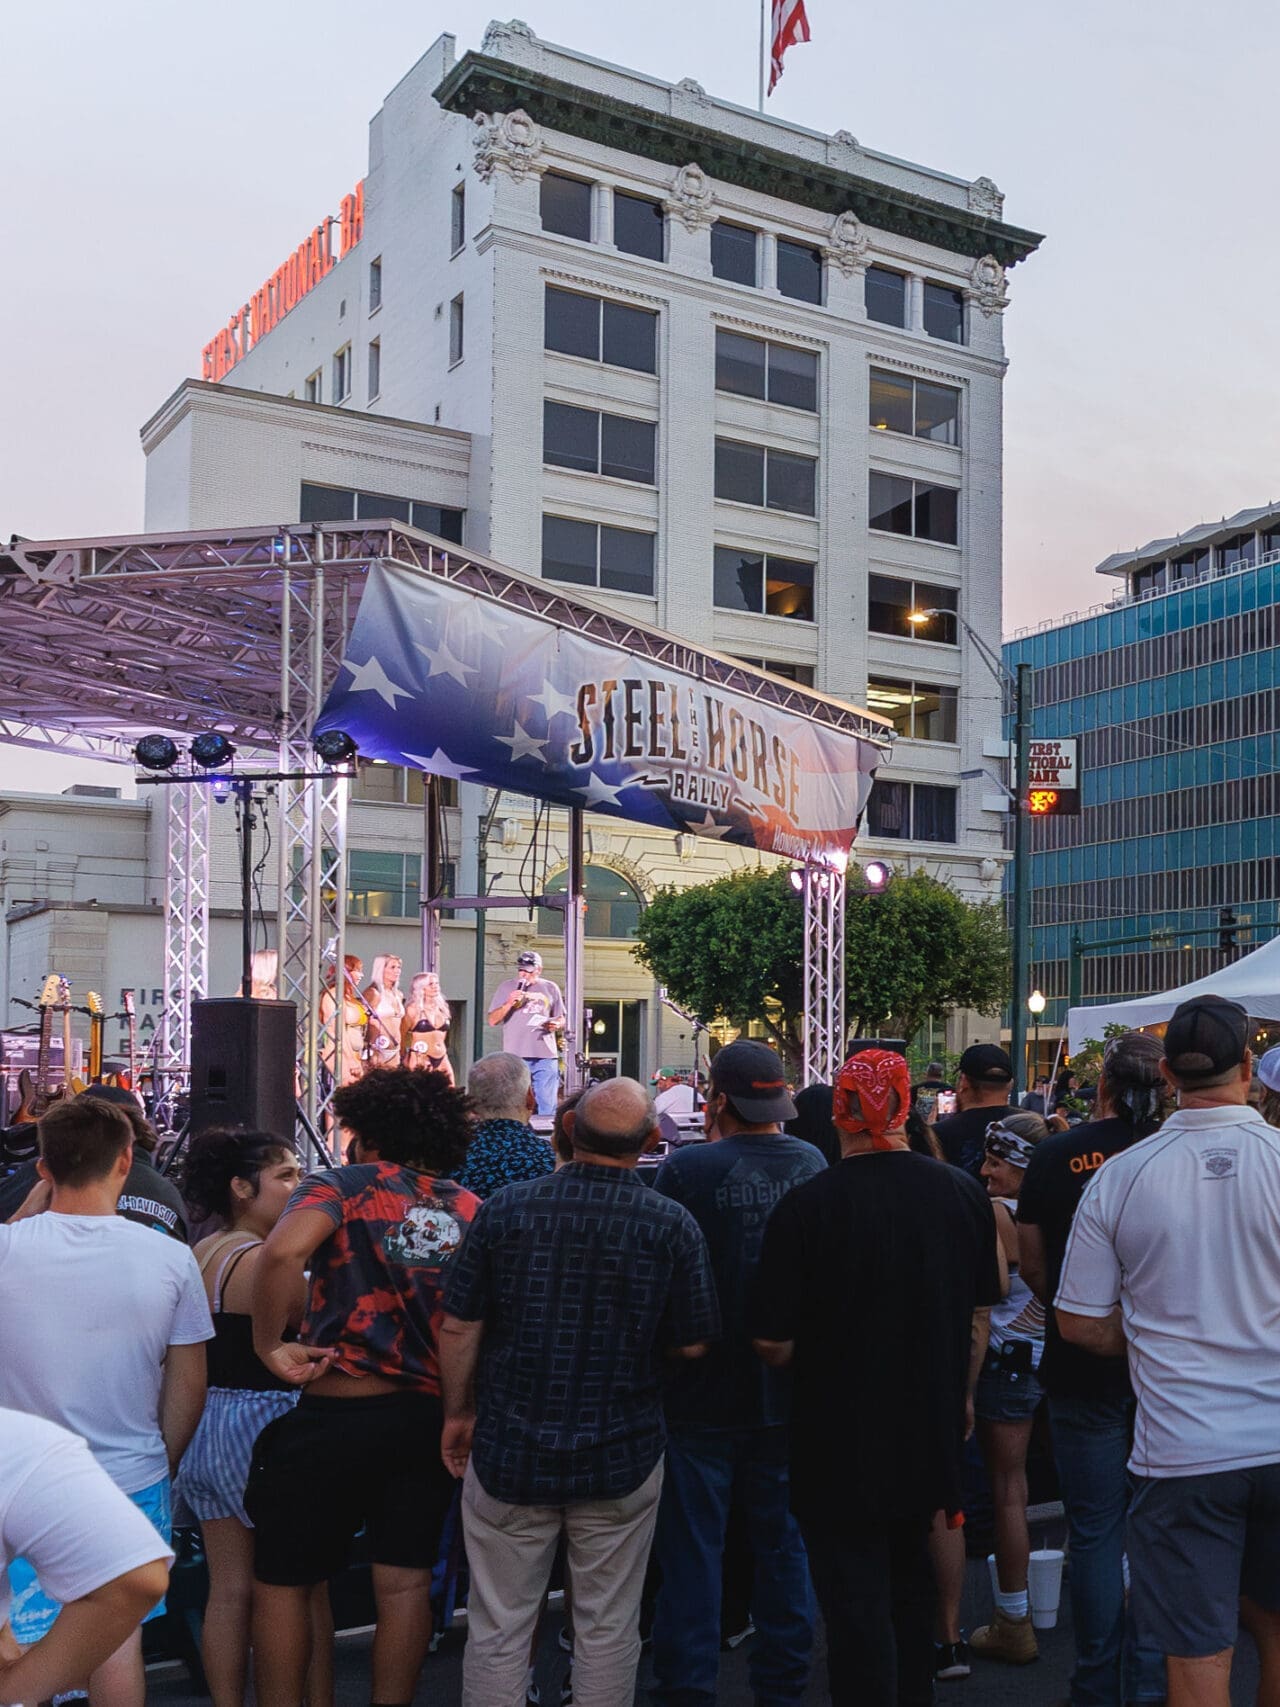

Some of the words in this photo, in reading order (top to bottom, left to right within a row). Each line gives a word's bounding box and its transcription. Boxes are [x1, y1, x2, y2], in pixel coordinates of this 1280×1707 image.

[202, 304, 249, 383] FIRST
[250, 215, 337, 349] NATIONAL
[570, 679, 687, 765] STEEL
[688, 688, 699, 748] THE
[703, 694, 800, 824] HORSE
[1015, 757, 1073, 769] TIONAL
[673, 773, 729, 809] RALLY
[1070, 1151, 1105, 1173] OLD
